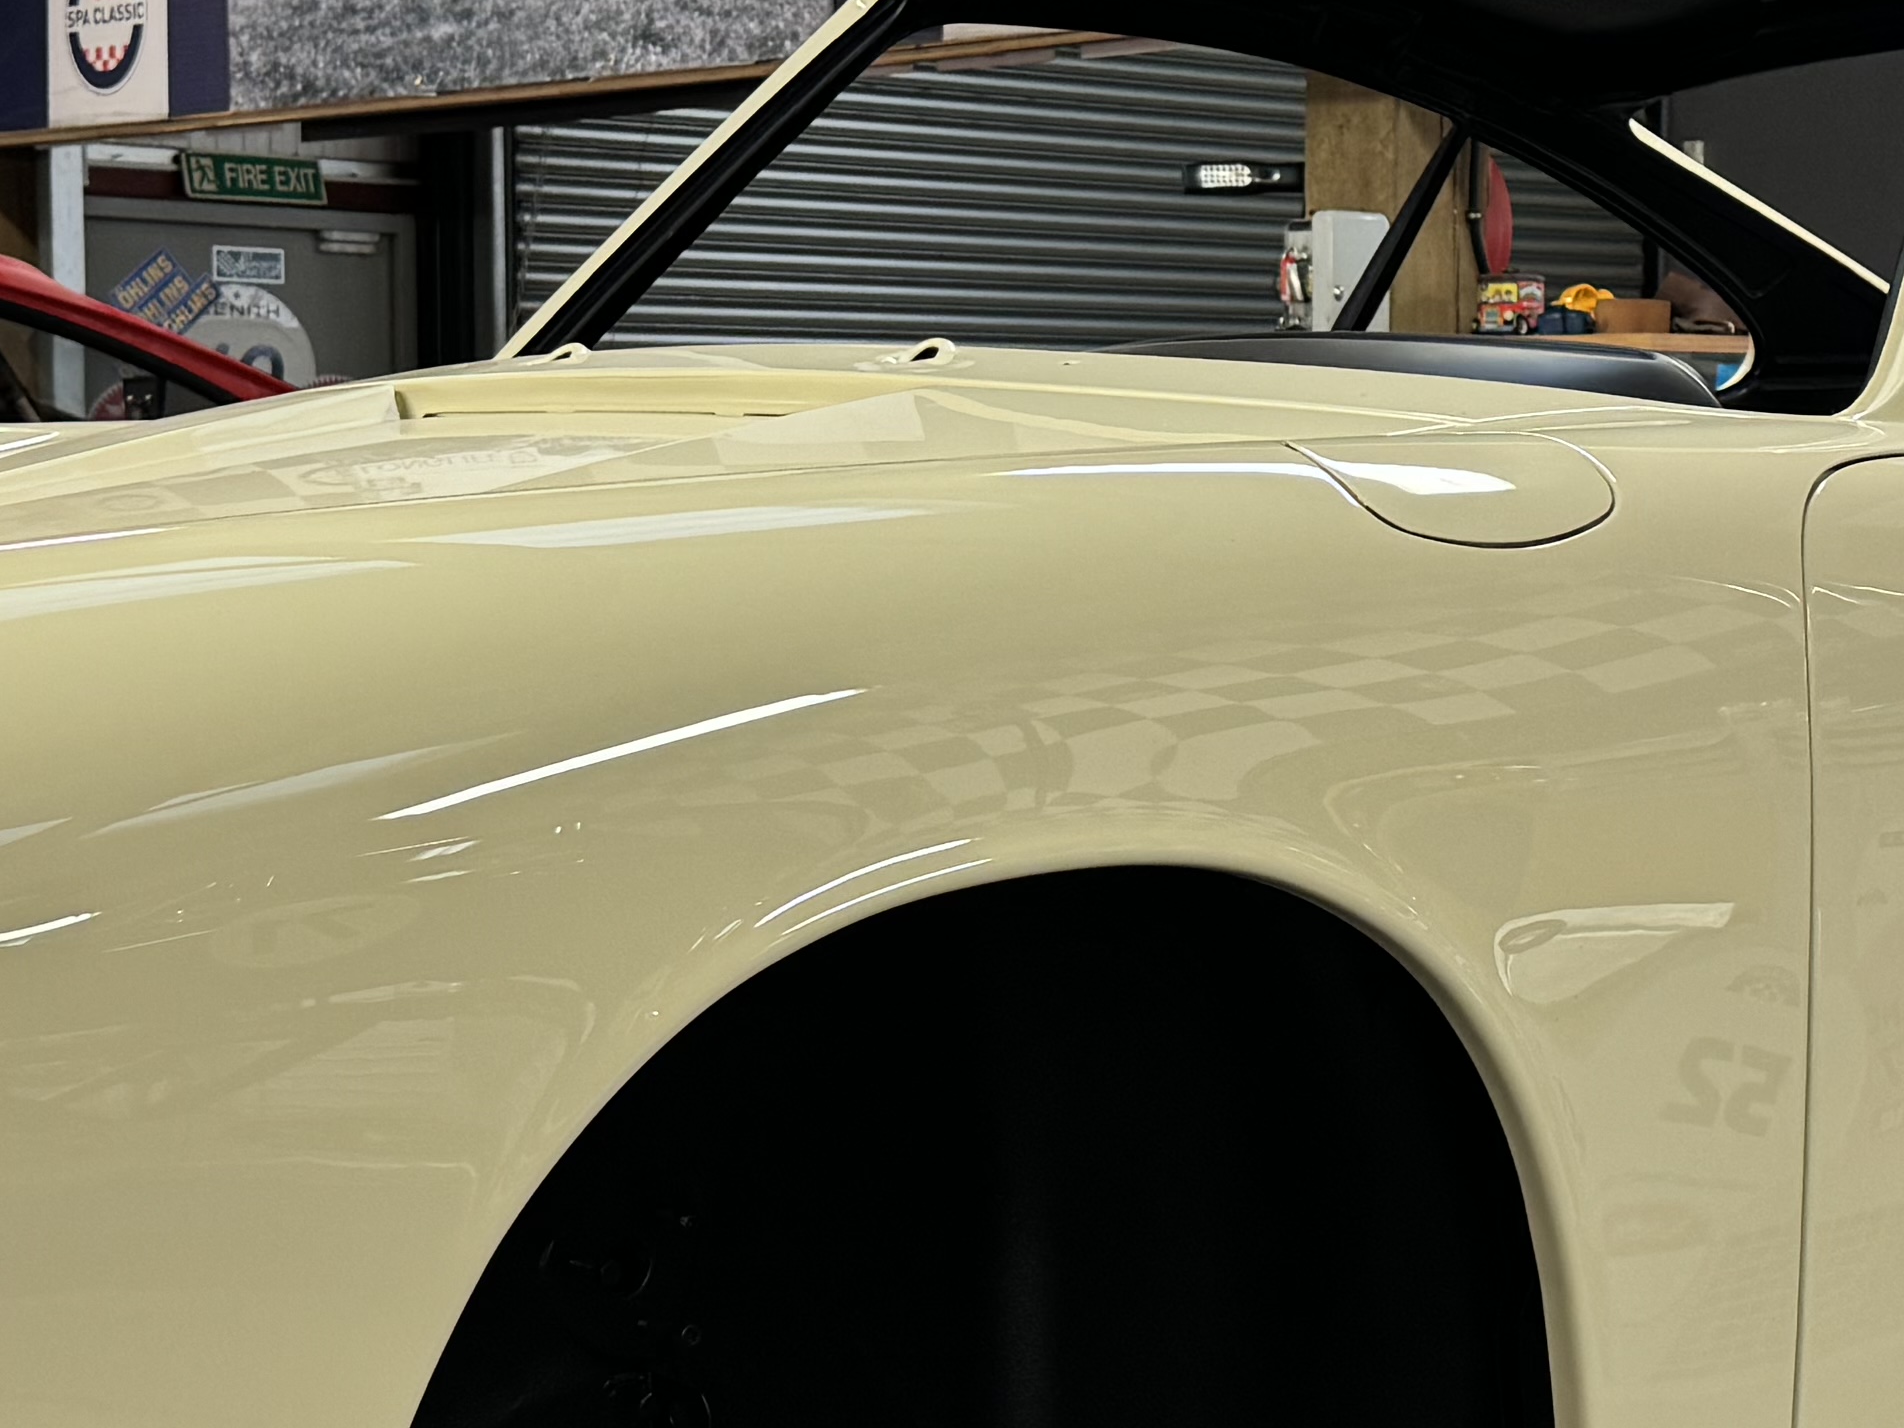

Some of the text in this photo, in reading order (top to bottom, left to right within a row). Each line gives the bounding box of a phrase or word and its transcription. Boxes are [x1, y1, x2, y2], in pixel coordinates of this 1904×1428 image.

[68, 1, 144, 28] SPA CLASSIC
[224, 162, 316, 194] FIRE EXIT
[211, 302, 281, 318] ENITH
